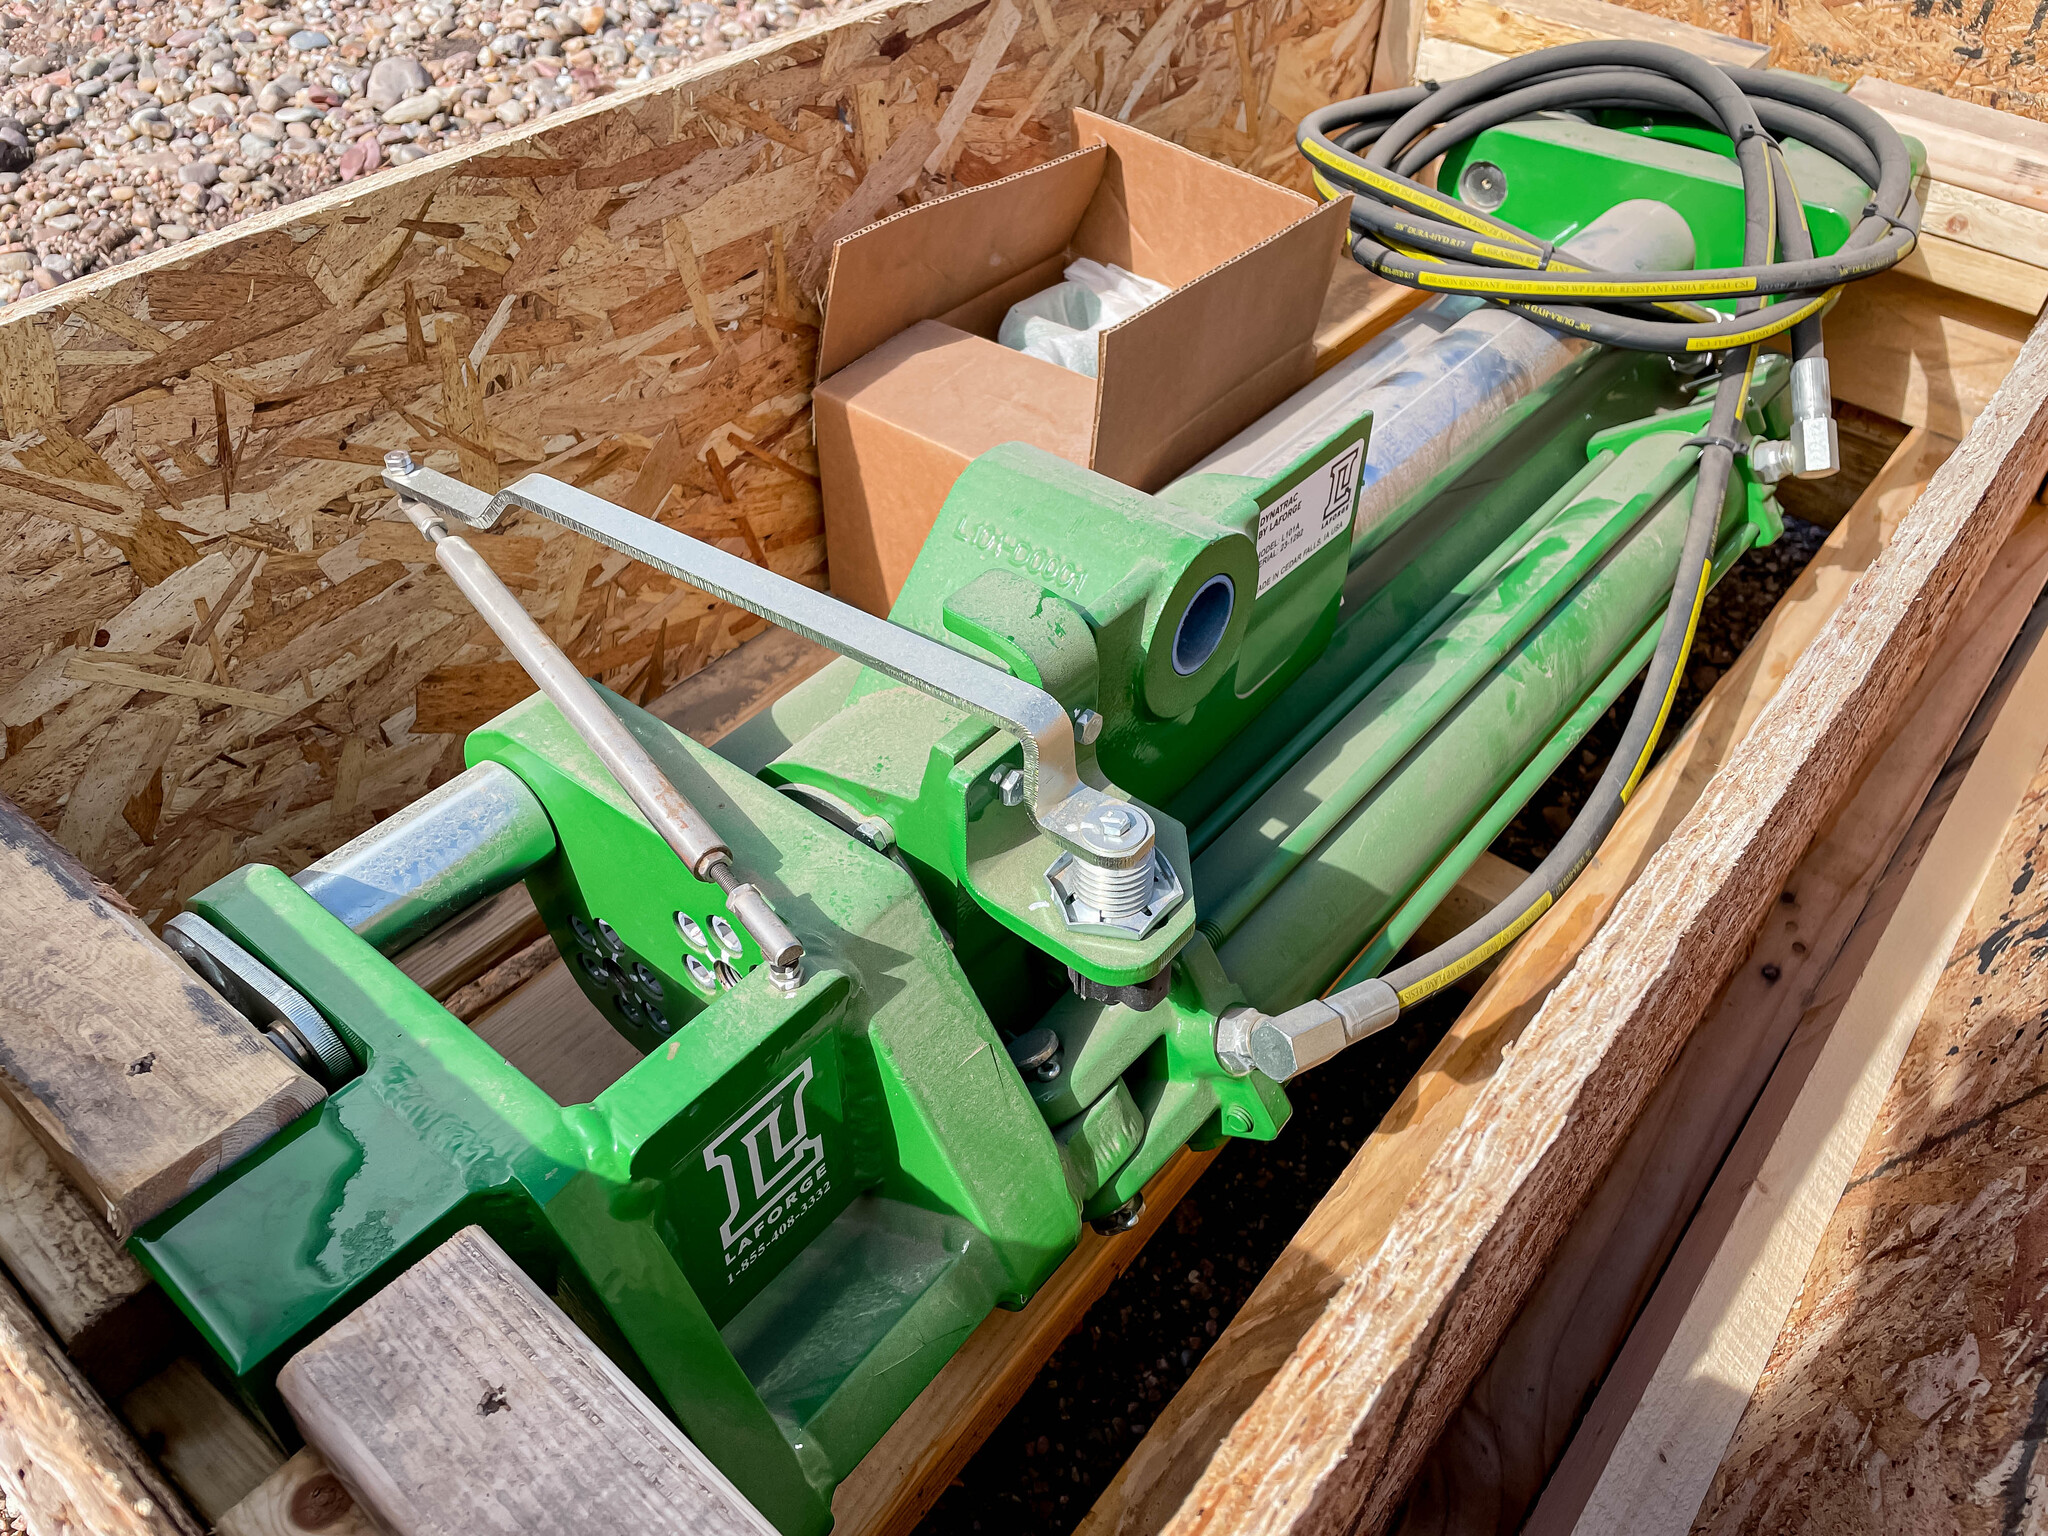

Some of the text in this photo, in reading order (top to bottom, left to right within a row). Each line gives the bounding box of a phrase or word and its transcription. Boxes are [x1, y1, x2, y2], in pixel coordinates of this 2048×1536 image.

[1406, 226, 1450, 245] DURA-HYD
[1424, 275, 1458, 287] ABRASION
[1458, 279, 1501, 290] RESISTANT
[1555, 284, 1570, 292] PSI
[1570, 284, 1586, 293] WP
[1586, 285, 1618, 294] FLAME
[1619, 284, 1669, 294] RESISTANT
[1530, 304, 1576, 328] DURA-HYD
[1258, 500, 1303, 541] BY LAFORGE
[1259, 492, 1299, 528] DYNATRAC
[1321, 503, 1350, 530] LAFORGE
[1258, 576, 1272, 592] ADE
[1272, 571, 1280, 581] IN
[1280, 553, 1302, 575] CEDAR
[1323, 532, 1330, 541] IA
[1330, 520, 1343, 536] USA
[1258, 549, 1280, 569] ERIAL:
[1423, 972, 1447, 989] FLAME
[724, 1162, 828, 1266] LAFORGE
[727, 1180, 831, 1286] 1-855-408-3332
